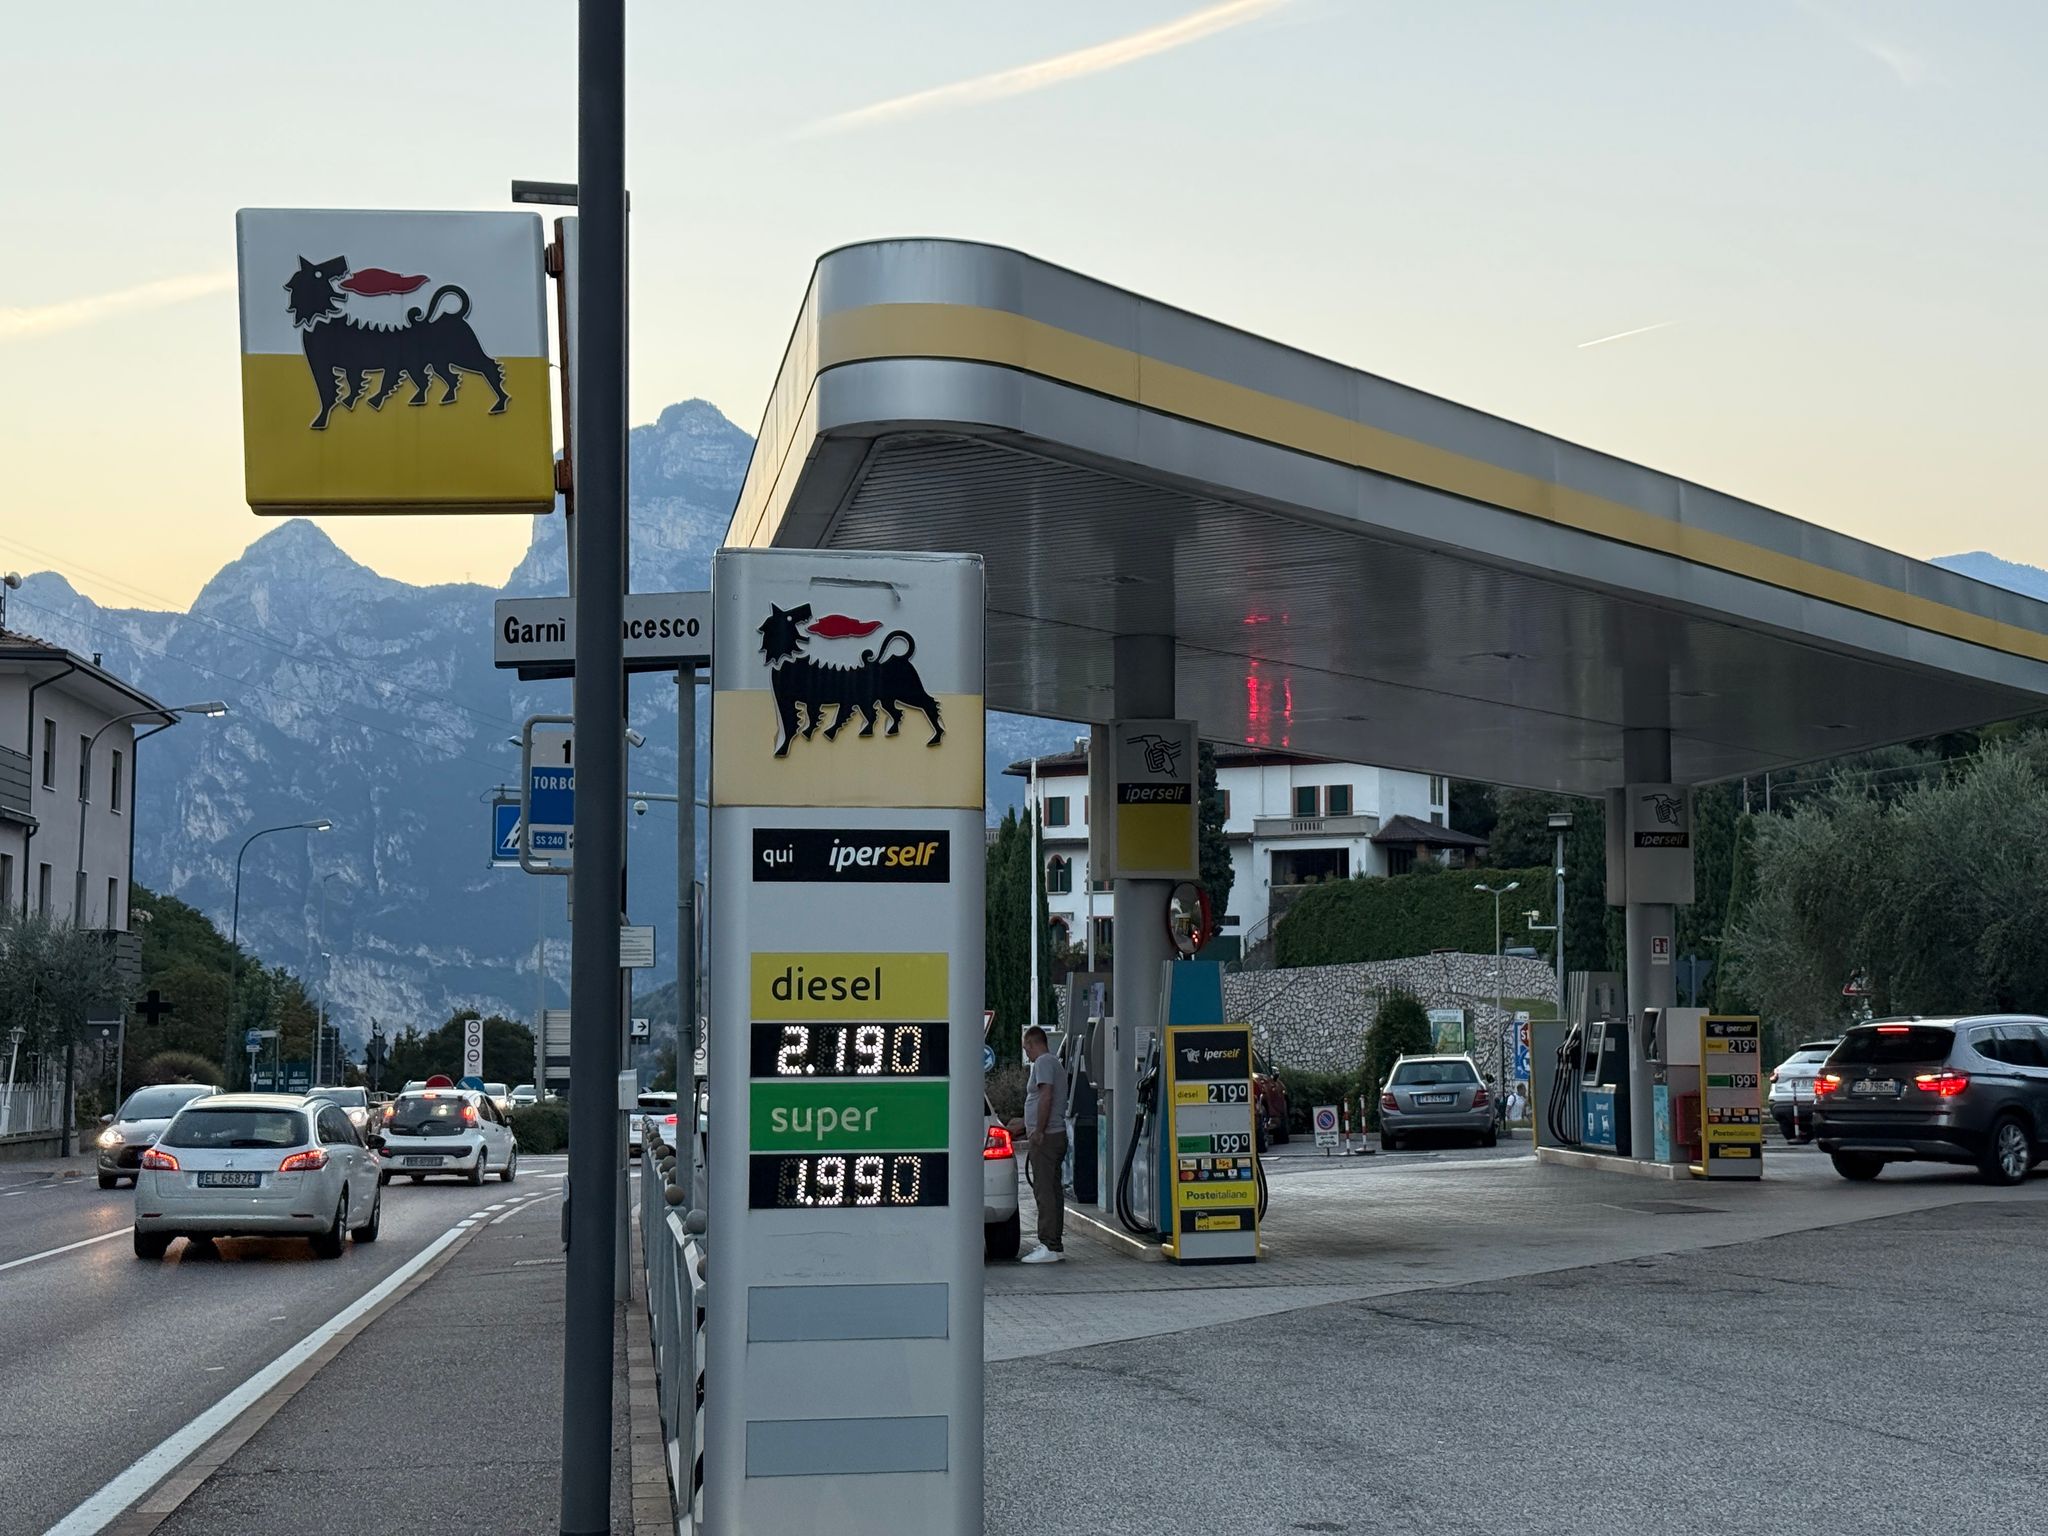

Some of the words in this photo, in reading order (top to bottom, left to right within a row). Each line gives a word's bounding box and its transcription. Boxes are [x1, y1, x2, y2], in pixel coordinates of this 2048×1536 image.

[503, 615, 566, 644] Garnì
[533, 775, 575, 790] TORBO
[1126, 784, 1185, 802] iperself
[535, 835, 546, 846] SS
[547, 834, 563, 846] 240
[1641, 832, 1686, 847] iperself
[762, 844, 794, 868] qui
[829, 838, 939, 872] iperself
[771, 966, 881, 1001] diesel
[777, 1025, 922, 1075] 2.190
[1203, 1047, 1241, 1062] iperself
[1177, 1090, 1199, 1099] diesel
[771, 1105, 879, 1141] super
[797, 1156, 922, 1206] 1.990
